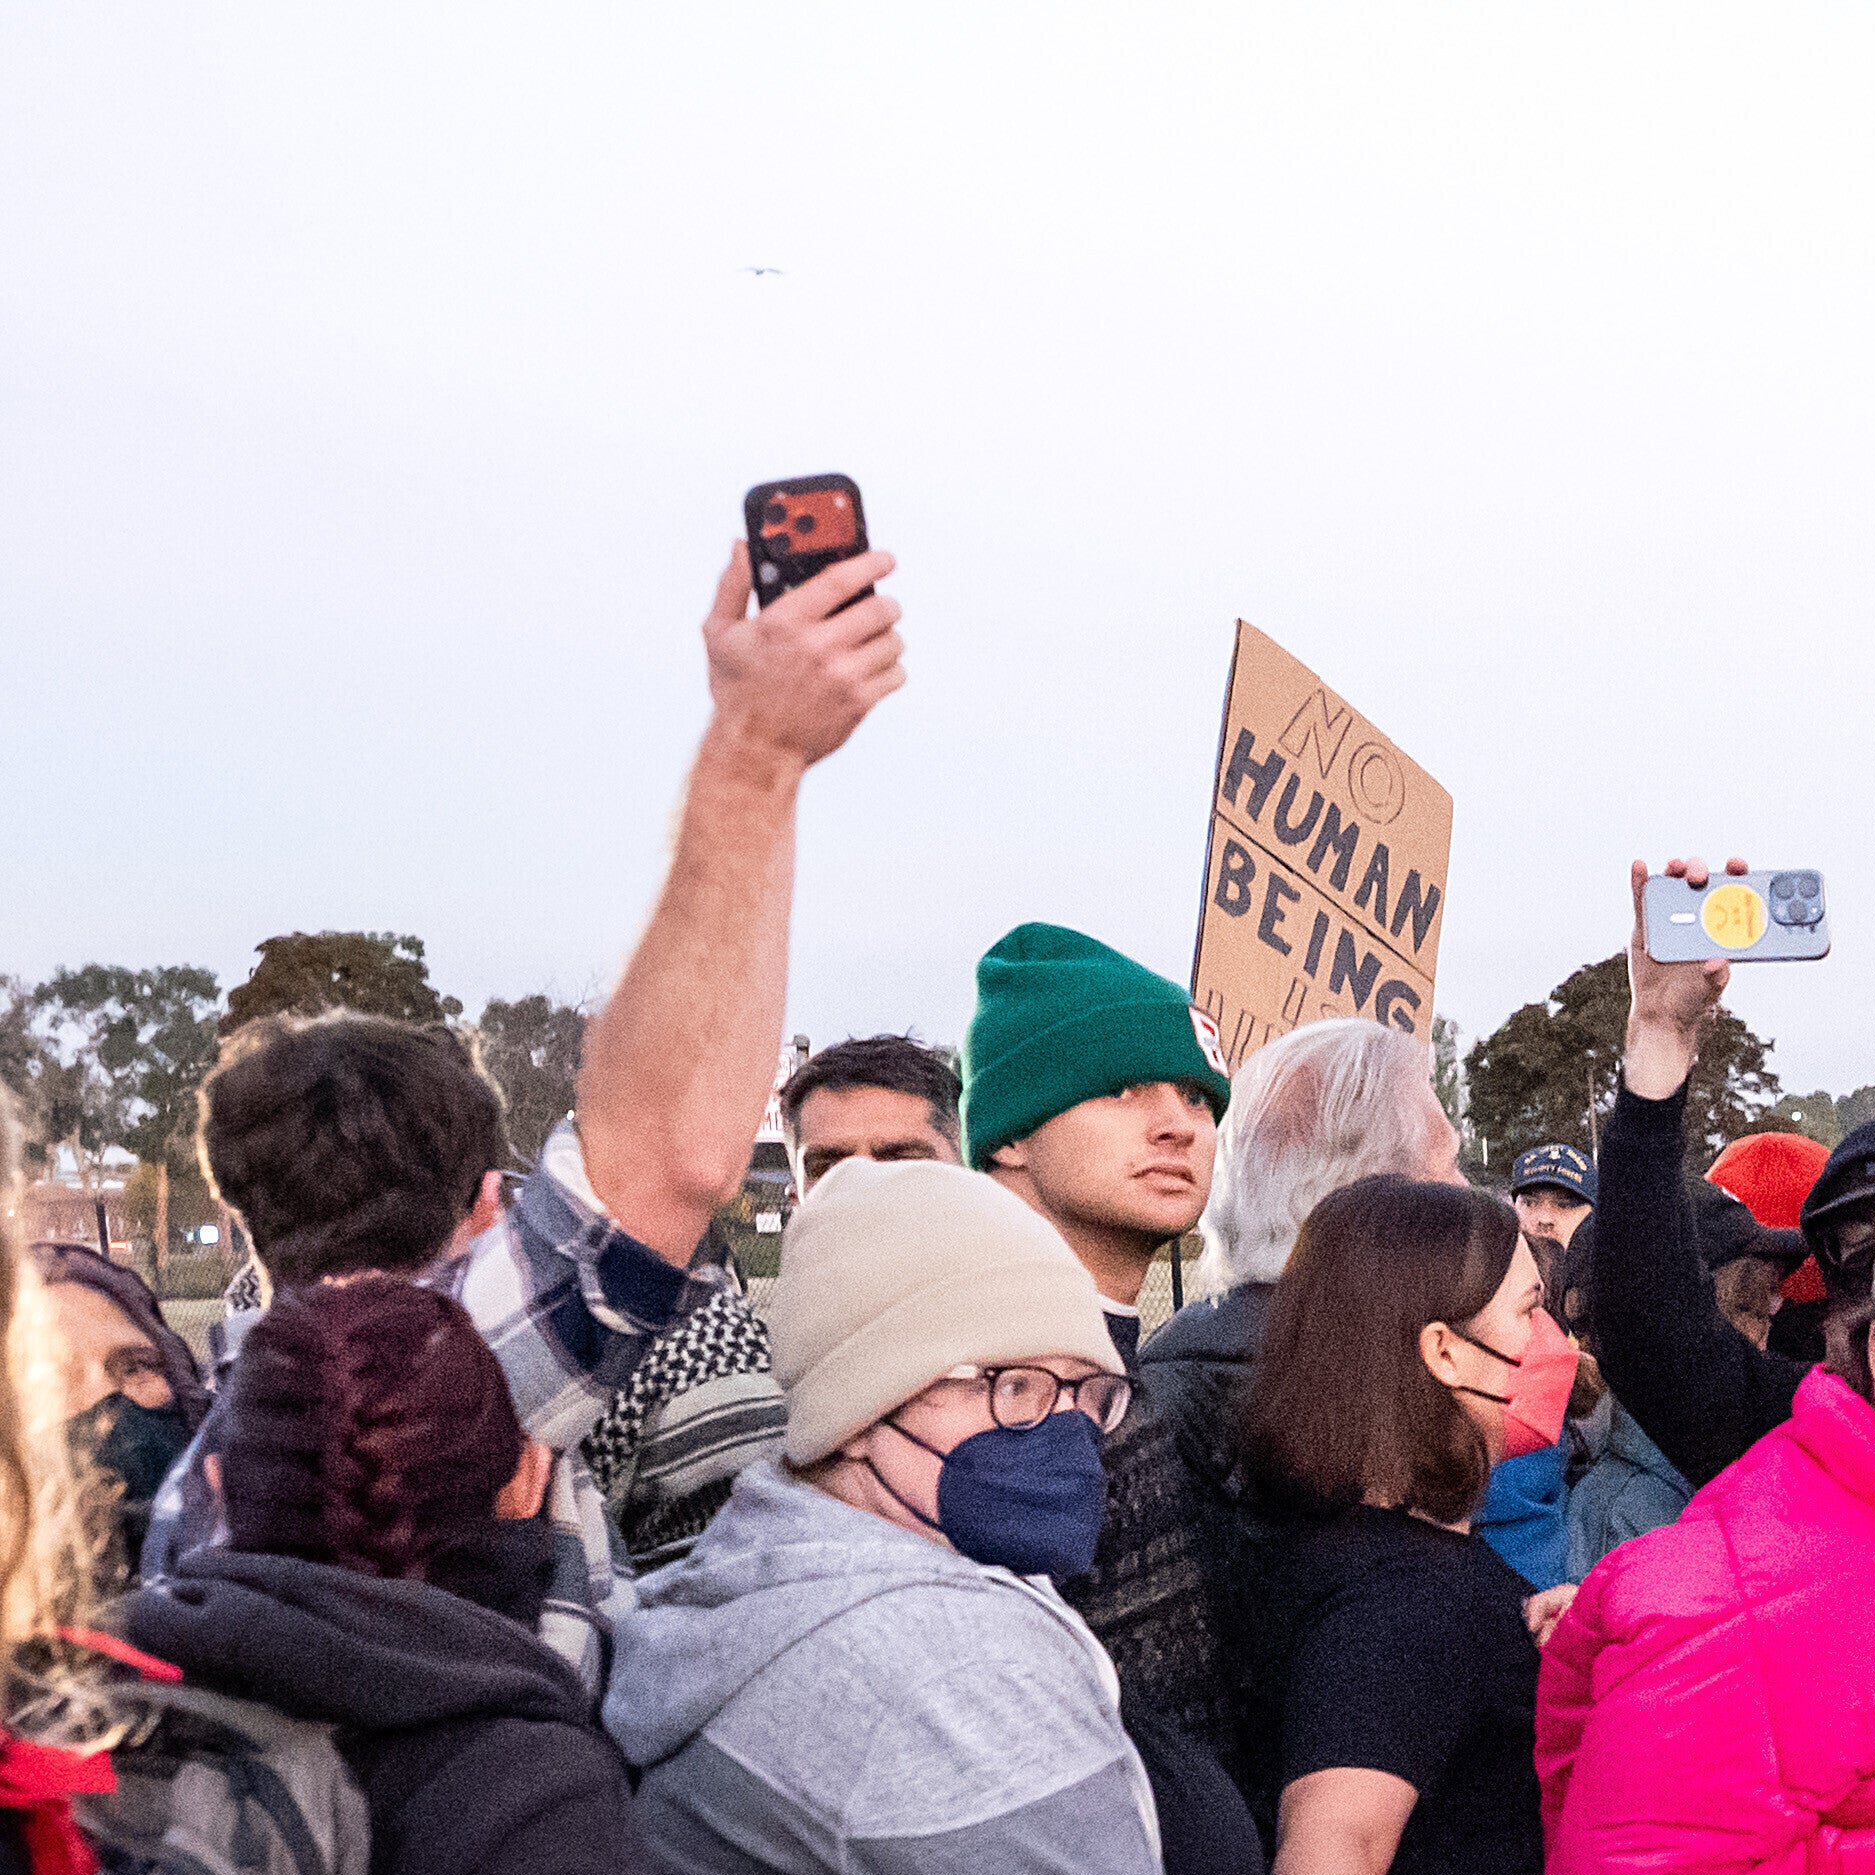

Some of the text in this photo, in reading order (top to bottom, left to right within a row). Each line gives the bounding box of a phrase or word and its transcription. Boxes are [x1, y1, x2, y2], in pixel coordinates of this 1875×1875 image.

[1221, 727, 1443, 954] HUMAN
[1277, 689, 1406, 825] NO
[1213, 838, 1423, 1036] BEING
